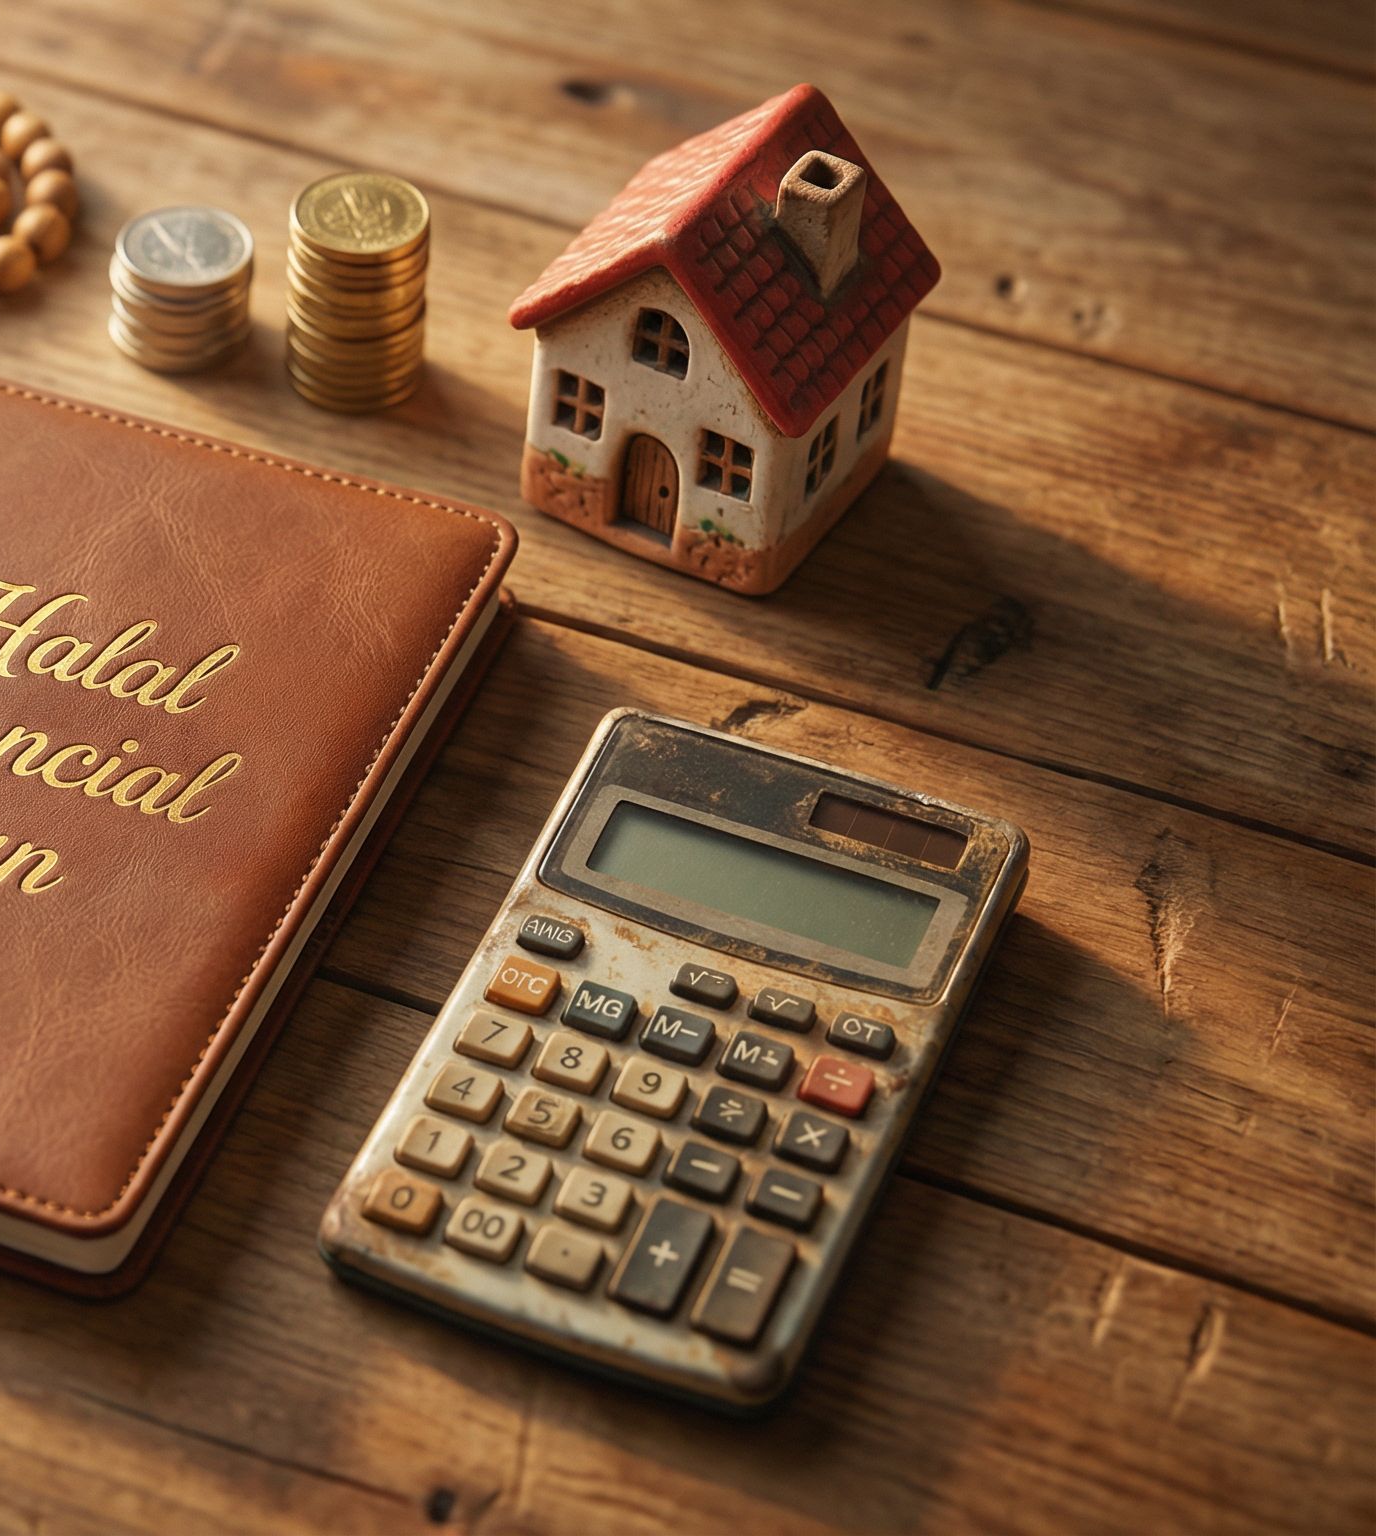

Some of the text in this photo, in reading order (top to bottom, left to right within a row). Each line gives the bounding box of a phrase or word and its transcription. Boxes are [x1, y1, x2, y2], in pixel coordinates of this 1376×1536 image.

[575, 989, 624, 1019] MG
[481, 1020, 509, 1044] 7
[559, 1046, 584, 1070] 8
[451, 1076, 476, 1101] 4
[638, 1071, 662, 1095] 9
[527, 1099, 558, 1125] 5
[427, 1130, 442, 1154] 1
[610, 1126, 635, 1151] 6
[498, 1155, 527, 1182] 2
[390, 1186, 415, 1210] 0
[580, 1181, 607, 1208] 3
[461, 1208, 506, 1239] 00
